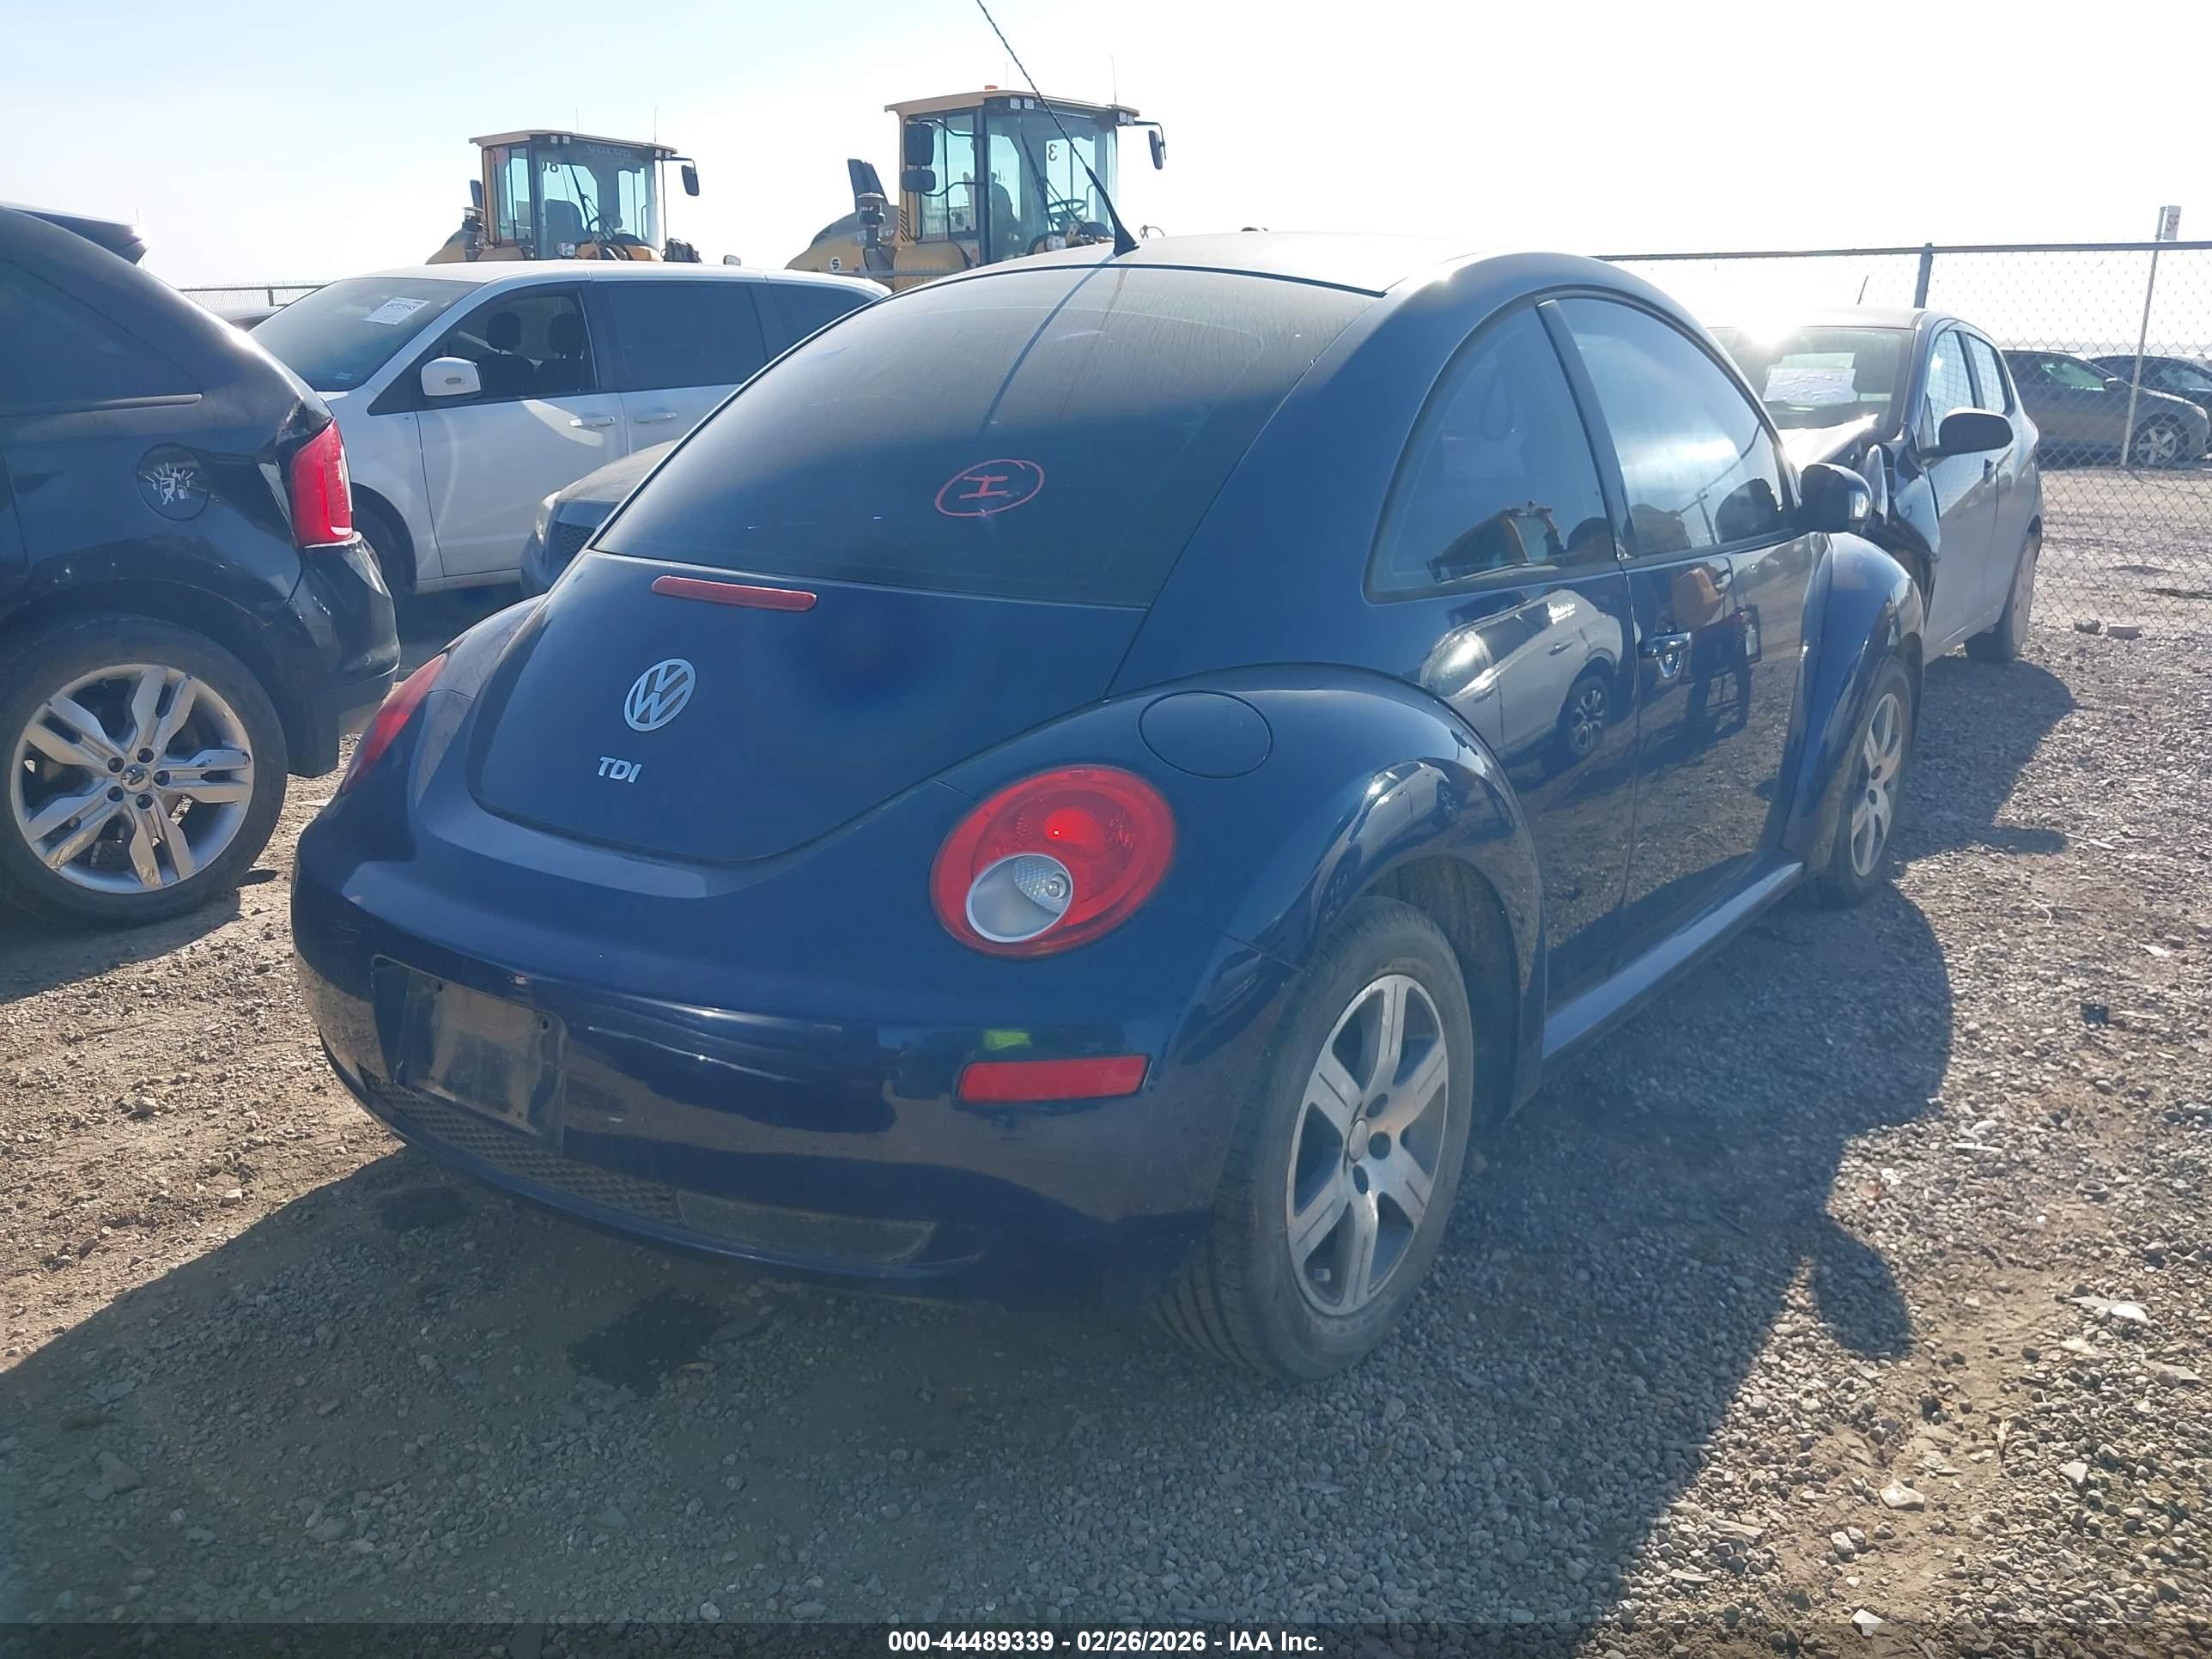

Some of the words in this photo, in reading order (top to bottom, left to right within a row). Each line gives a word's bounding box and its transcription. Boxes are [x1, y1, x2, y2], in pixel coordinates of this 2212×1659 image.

[585, 144, 632, 158] VOLVO
[626, 659, 696, 731] VW
[599, 757, 641, 783] TDI
